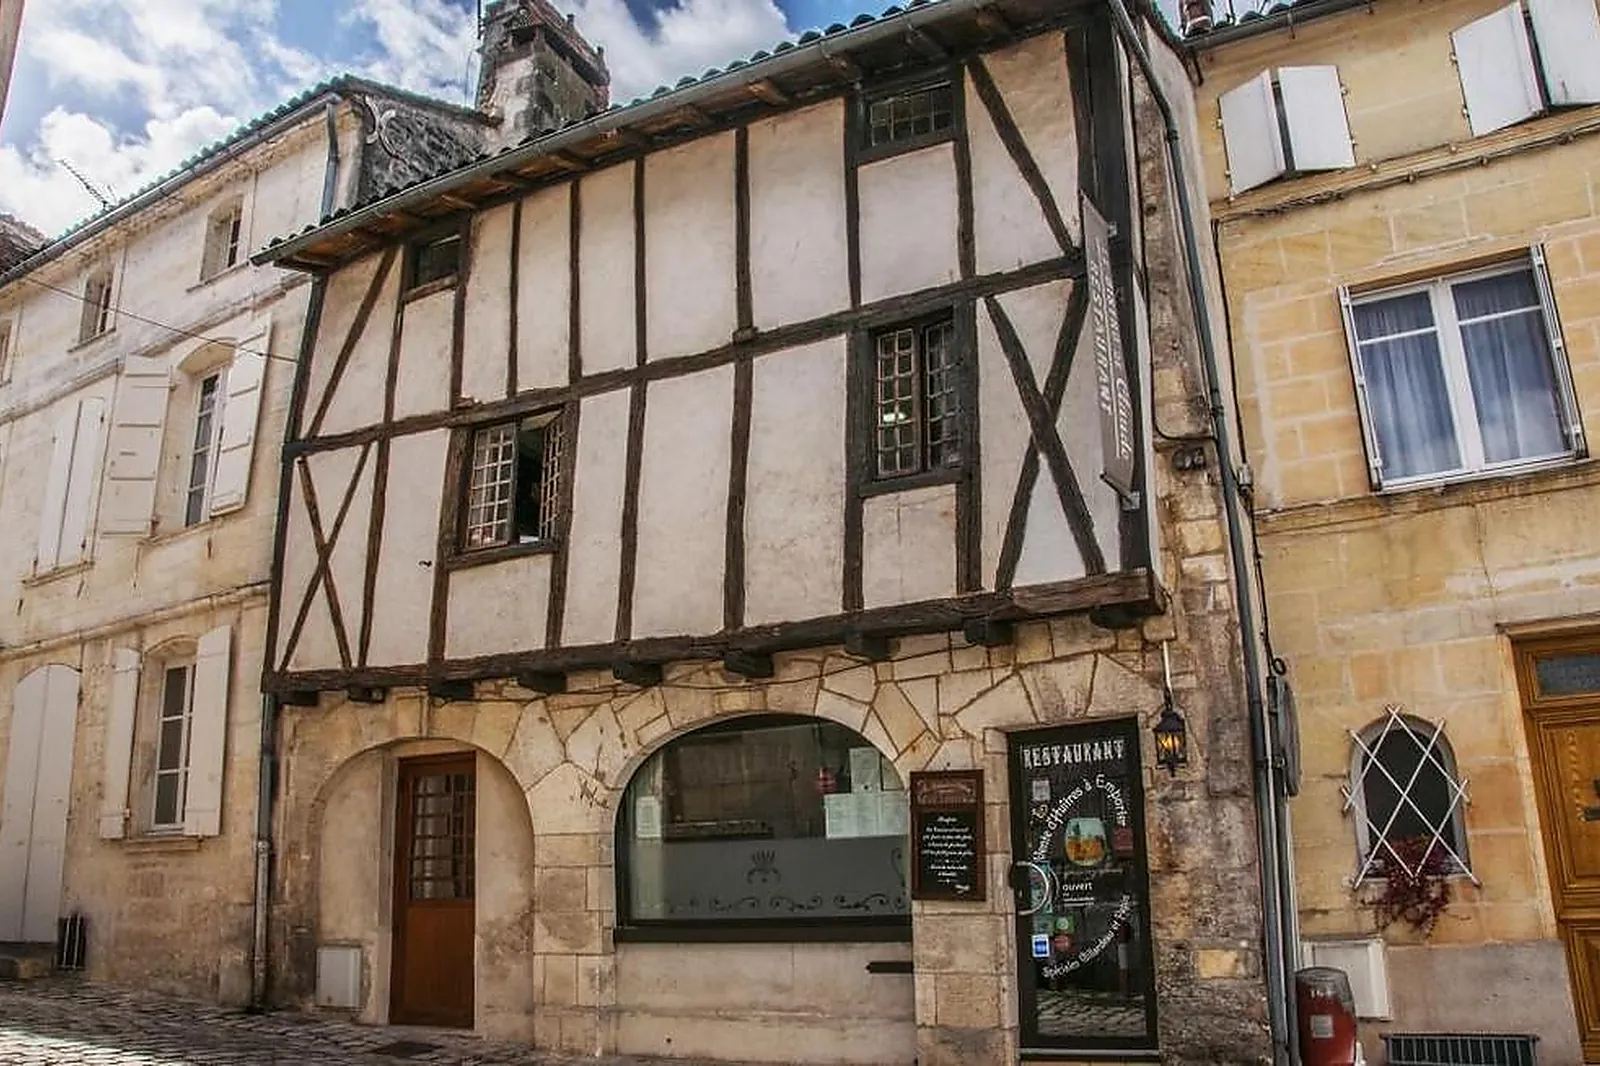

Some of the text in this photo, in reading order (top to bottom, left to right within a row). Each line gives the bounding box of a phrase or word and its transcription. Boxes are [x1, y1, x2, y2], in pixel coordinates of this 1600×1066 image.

[1090, 260, 1112, 416] RESTAURANT
[1116, 377, 1133, 460] Claude
[1022, 740, 1125, 770] RESTAURANT
